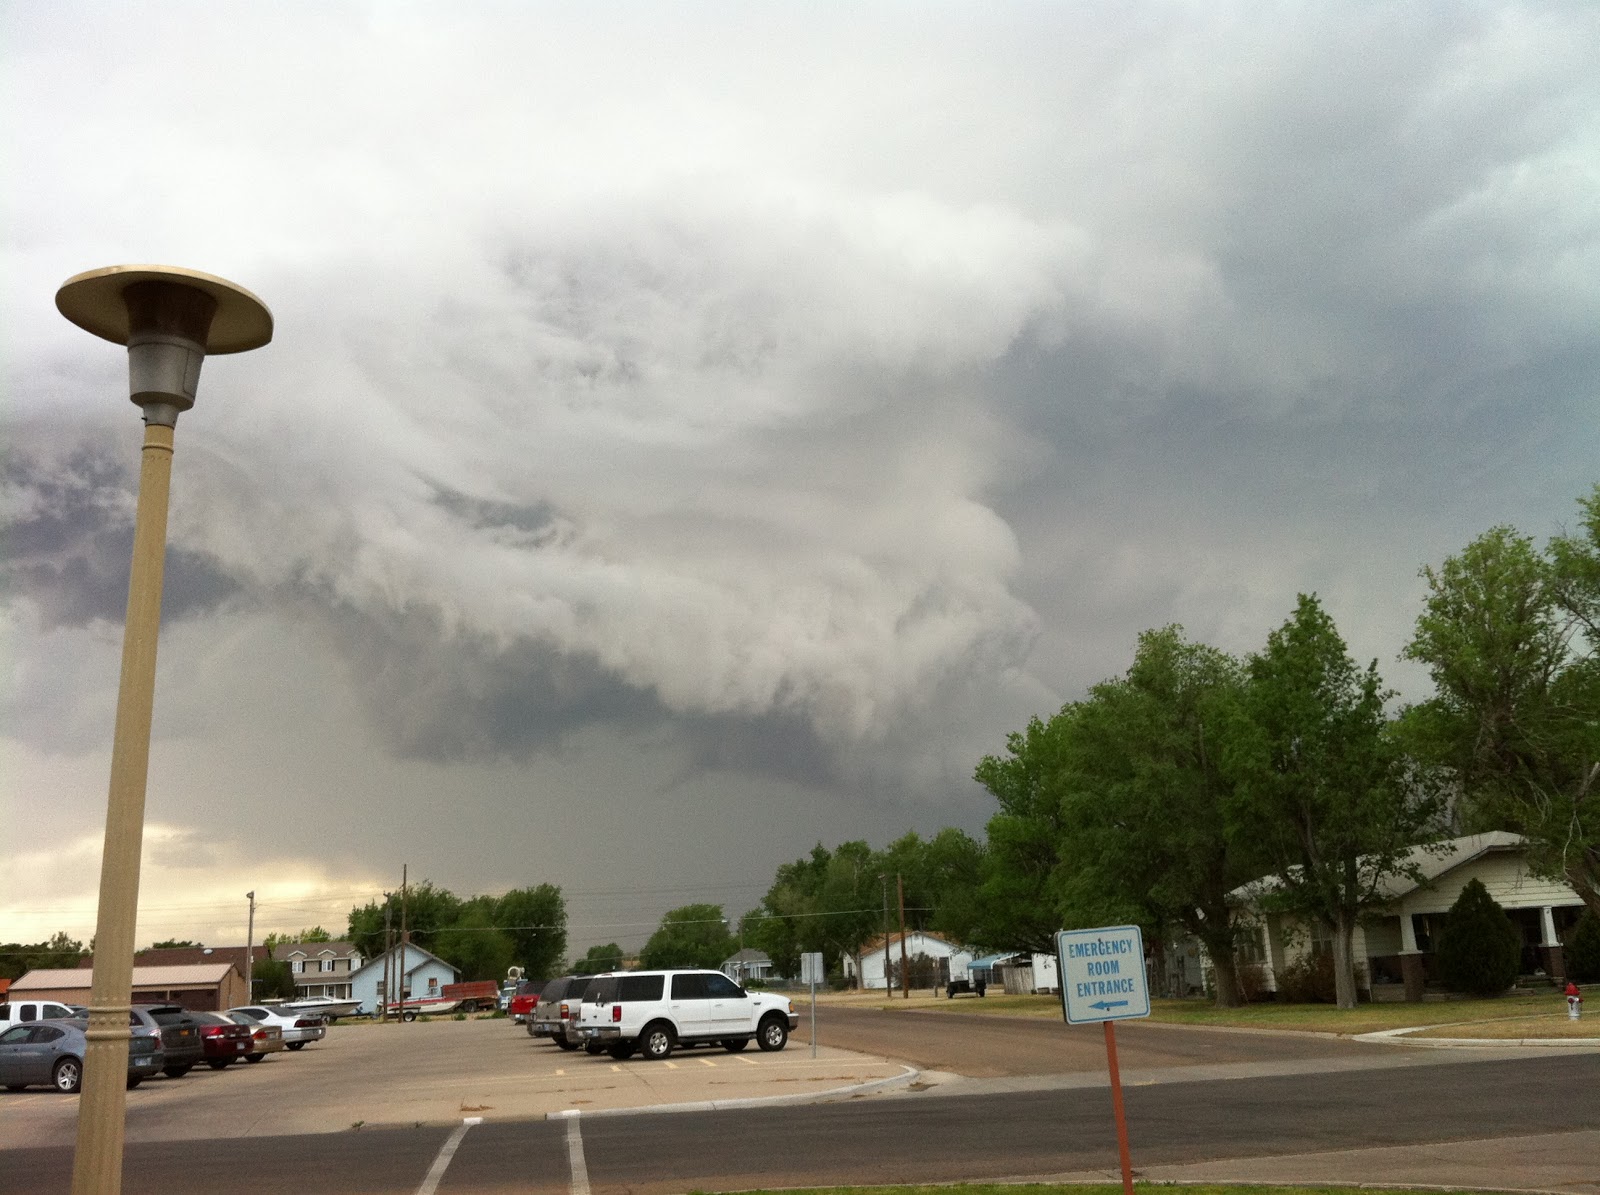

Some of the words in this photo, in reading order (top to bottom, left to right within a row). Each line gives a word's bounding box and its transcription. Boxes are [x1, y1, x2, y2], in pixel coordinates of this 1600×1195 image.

[1068, 939, 1132, 958] EMERGENCY
[1087, 960, 1120, 976] ROOM
[1077, 978, 1134, 997] ENTRANCE
